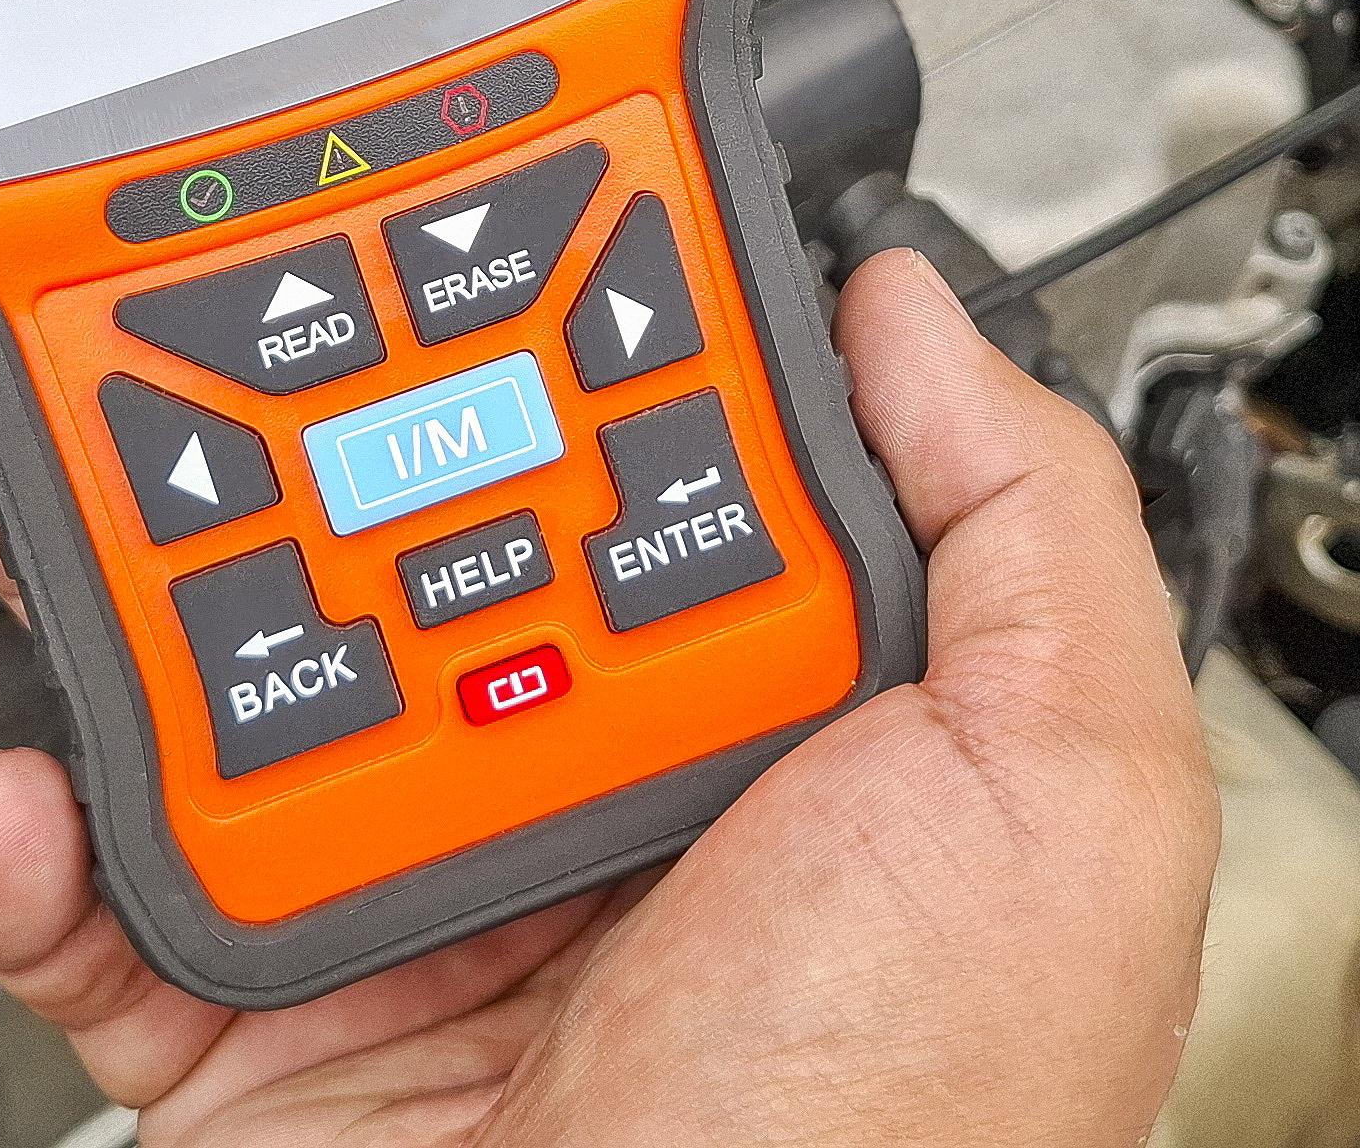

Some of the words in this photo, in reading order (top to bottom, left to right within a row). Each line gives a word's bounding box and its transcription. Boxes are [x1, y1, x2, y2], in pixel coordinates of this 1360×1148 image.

[421, 248, 537, 314] ERASE
[256, 312, 356, 370] READ
[386, 405, 489, 481] I/M
[419, 537, 534, 609] HELP
[608, 502, 755, 582] ENTER
[228, 643, 359, 724] BACK
